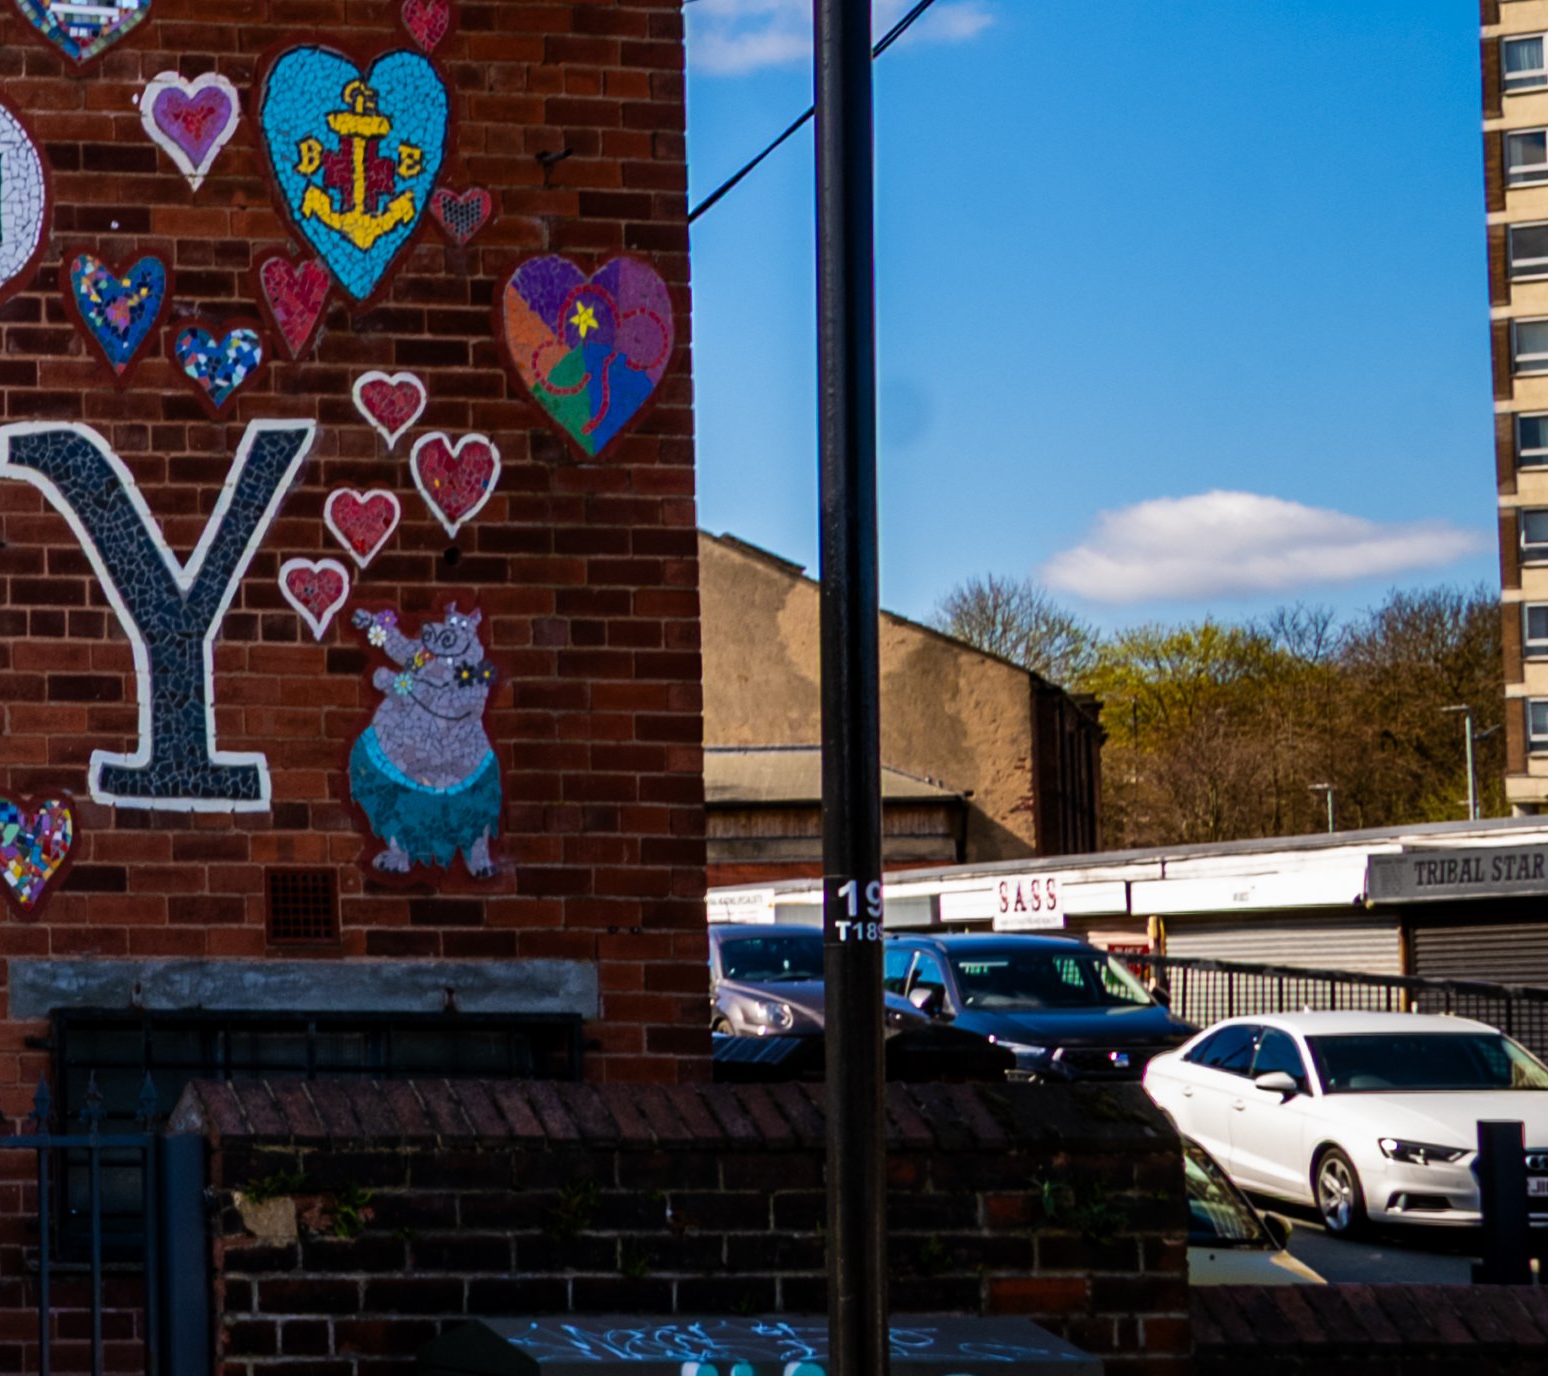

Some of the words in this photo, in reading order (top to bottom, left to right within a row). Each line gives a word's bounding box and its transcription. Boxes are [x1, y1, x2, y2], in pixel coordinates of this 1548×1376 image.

[1414, 858, 1485, 886] TRIBAL
[1492, 853, 1545, 881] STAR
[838, 880, 883, 917] 19
[999, 878, 1057, 913] SASS
